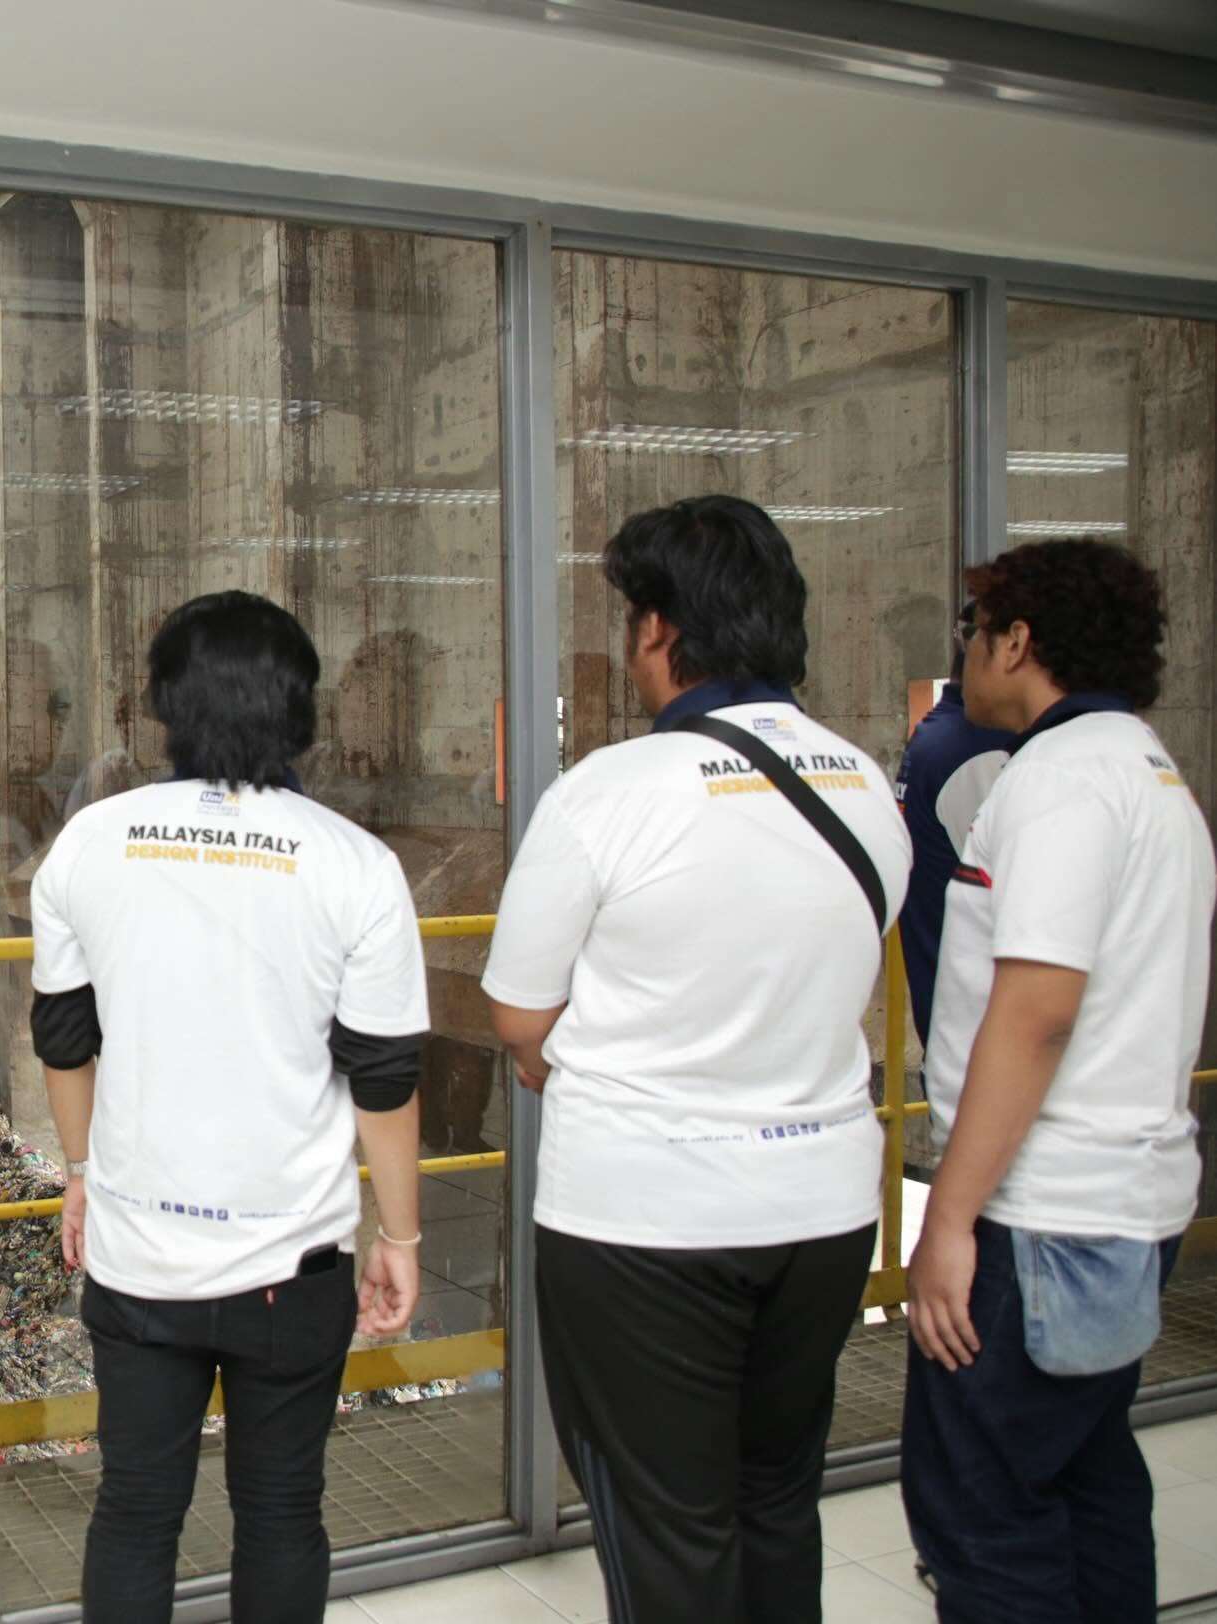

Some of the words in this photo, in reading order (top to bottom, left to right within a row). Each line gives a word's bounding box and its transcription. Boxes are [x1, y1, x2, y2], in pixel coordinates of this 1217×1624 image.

[699, 755, 807, 777] MALIA
[811, 754, 859, 772] ITALY
[127, 825, 237, 847] MALAYSIA
[243, 832, 302, 856] ITALY
[125, 844, 198, 863] DESIGN
[203, 847, 298, 875] INSTITUTE
